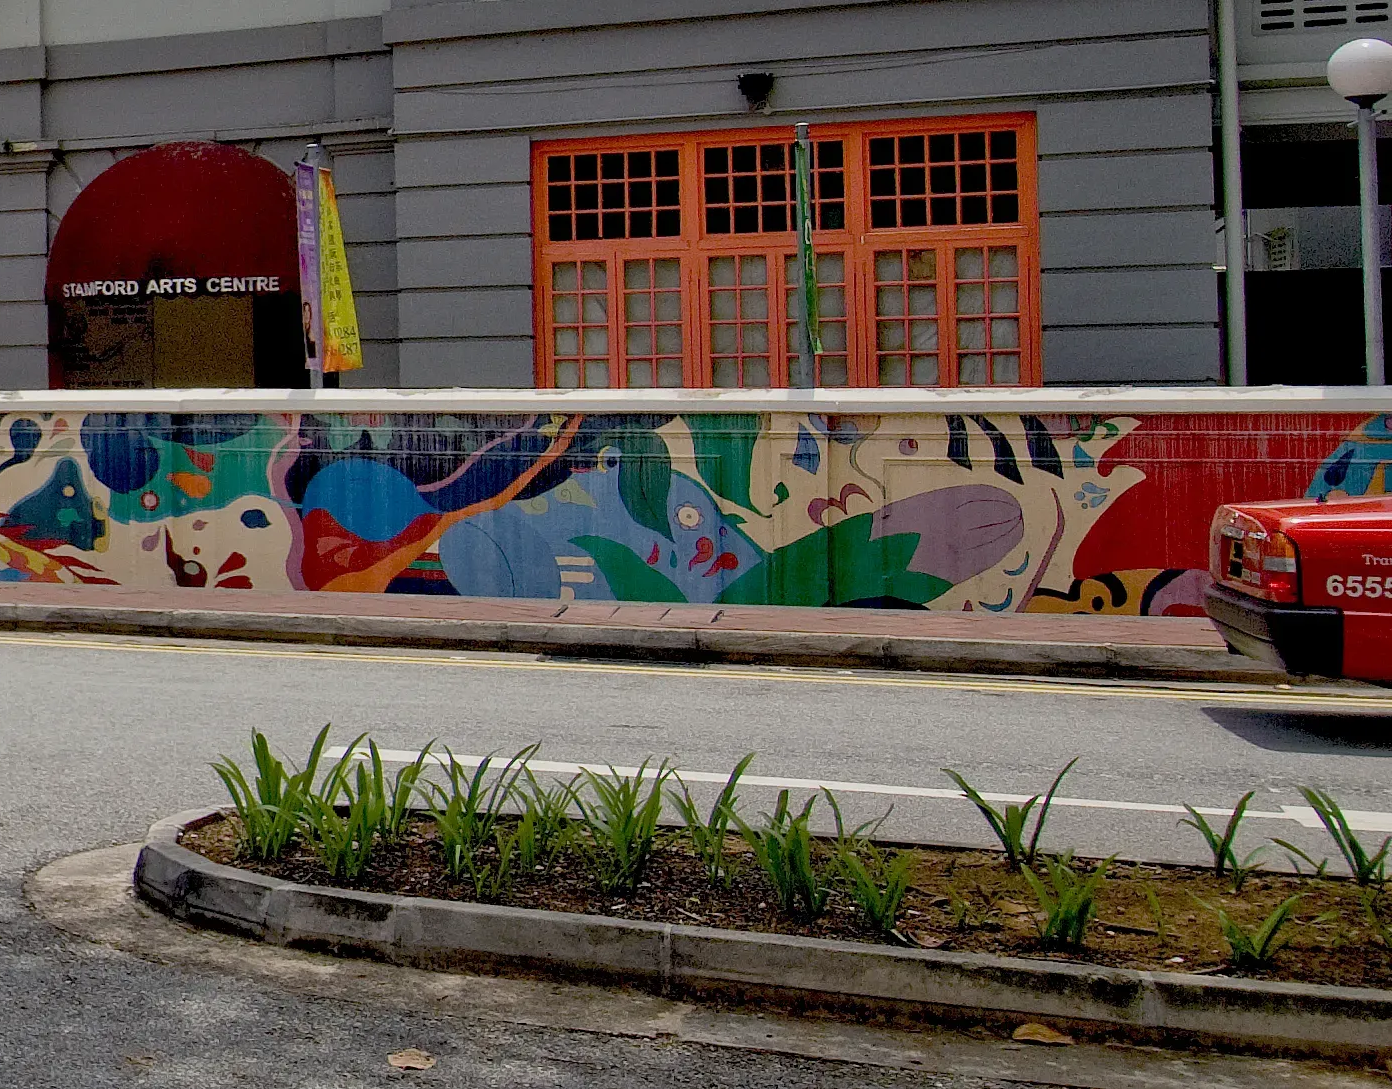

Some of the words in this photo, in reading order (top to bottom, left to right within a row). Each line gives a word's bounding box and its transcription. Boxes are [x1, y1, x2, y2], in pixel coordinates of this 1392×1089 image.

[62, 280, 139, 298] STAMFORD
[145, 278, 198, 295] ARTS
[205, 276, 280, 293] CENTRE
[1361, 553, 1392, 566] Tra
